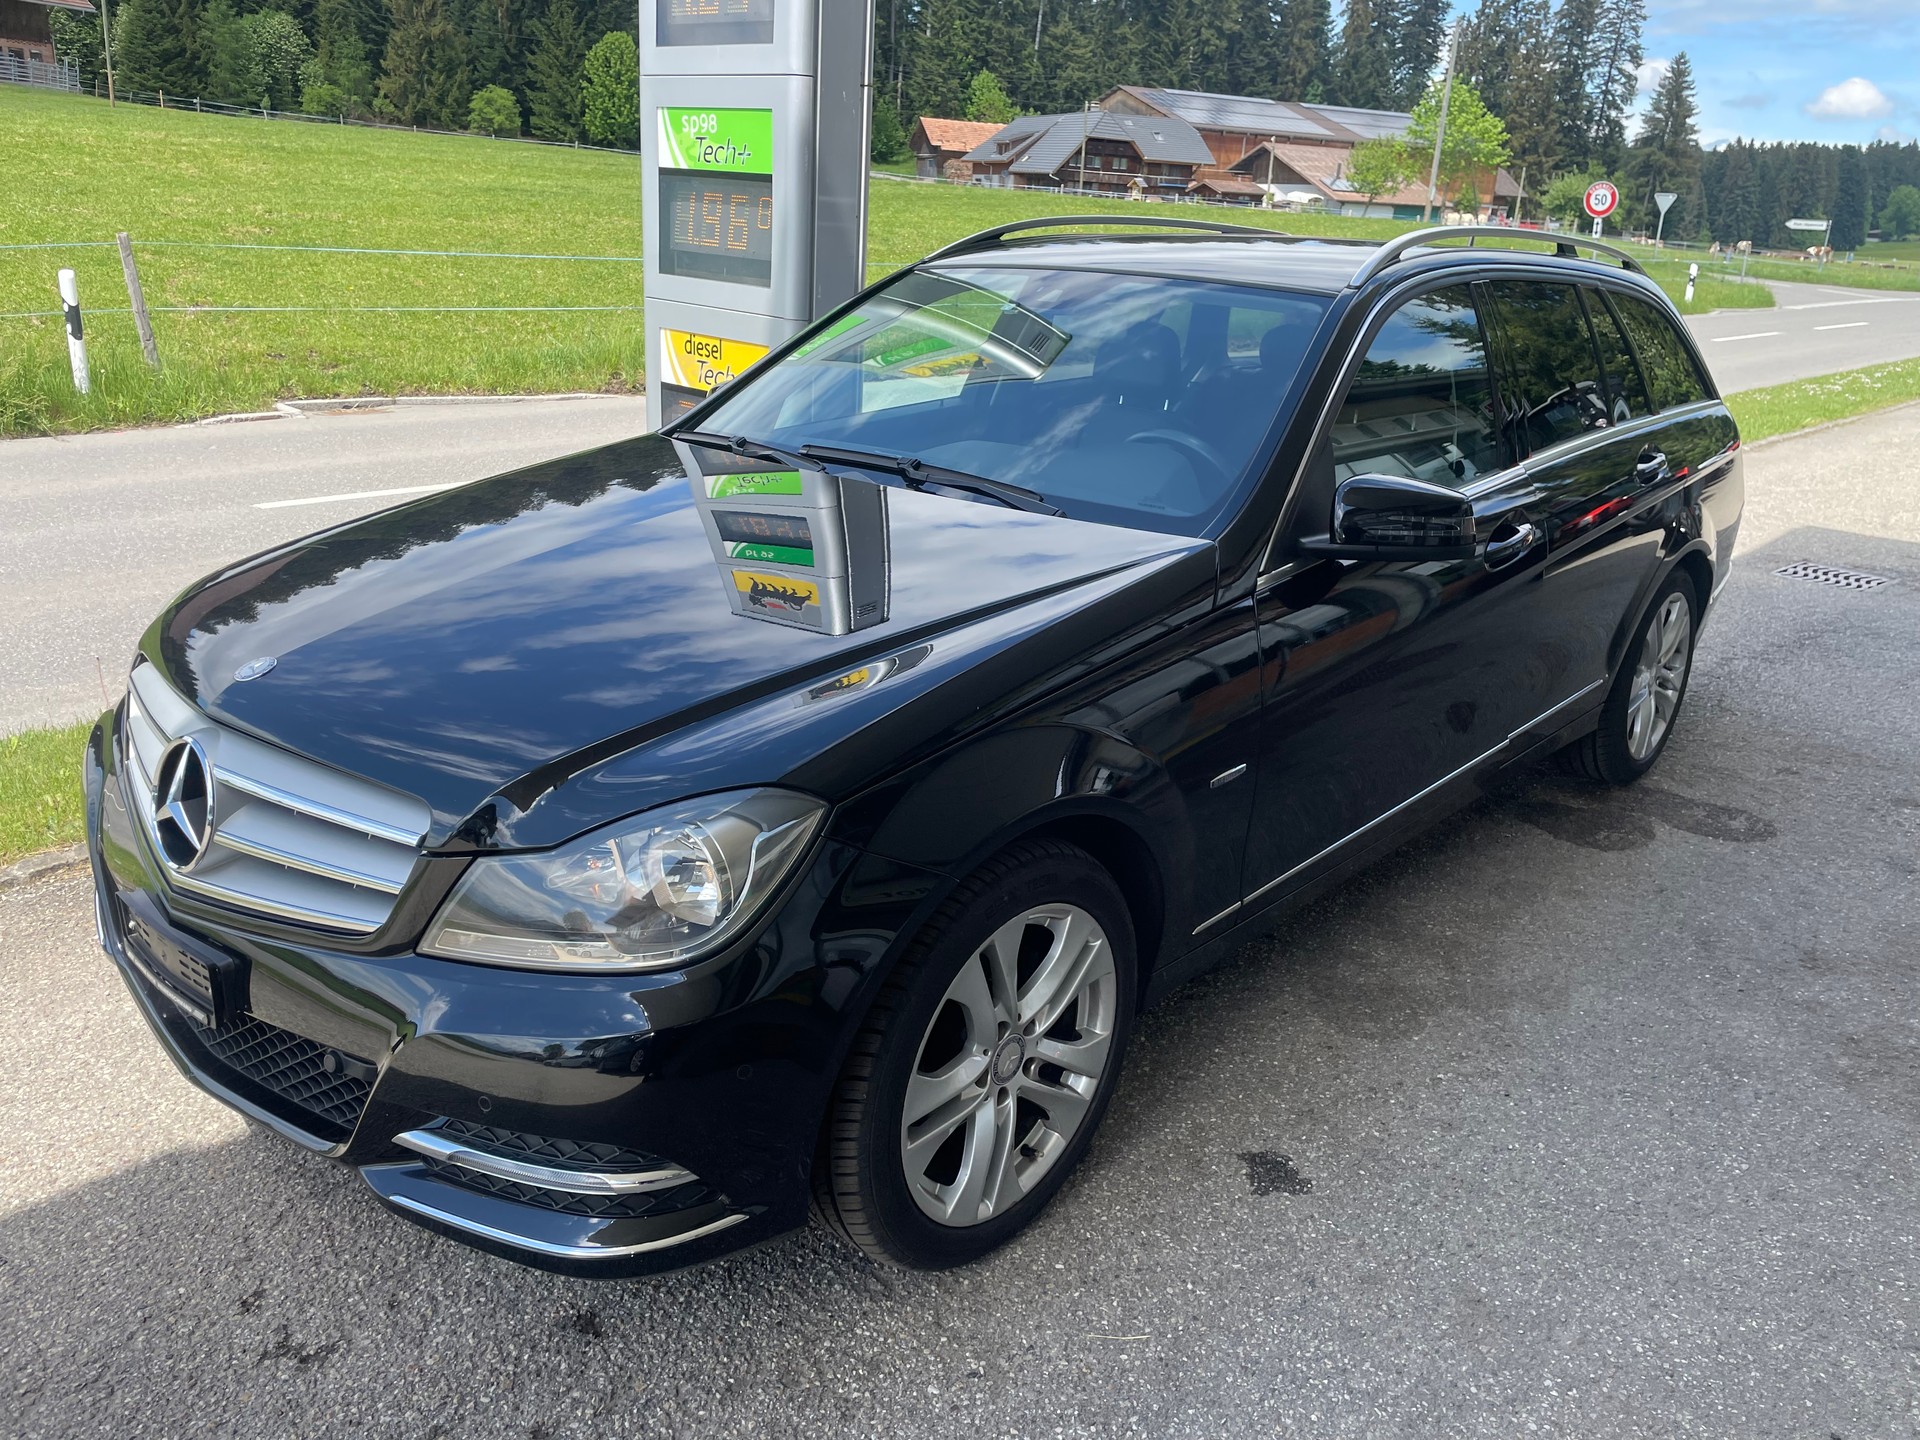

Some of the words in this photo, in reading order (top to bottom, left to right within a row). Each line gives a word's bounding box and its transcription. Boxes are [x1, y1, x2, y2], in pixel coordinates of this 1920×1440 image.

[681, 113, 718, 138] sp98
[695, 136, 752, 165] Tech+
[1594, 193, 1608, 206] 50
[684, 333, 723, 361] diesel
